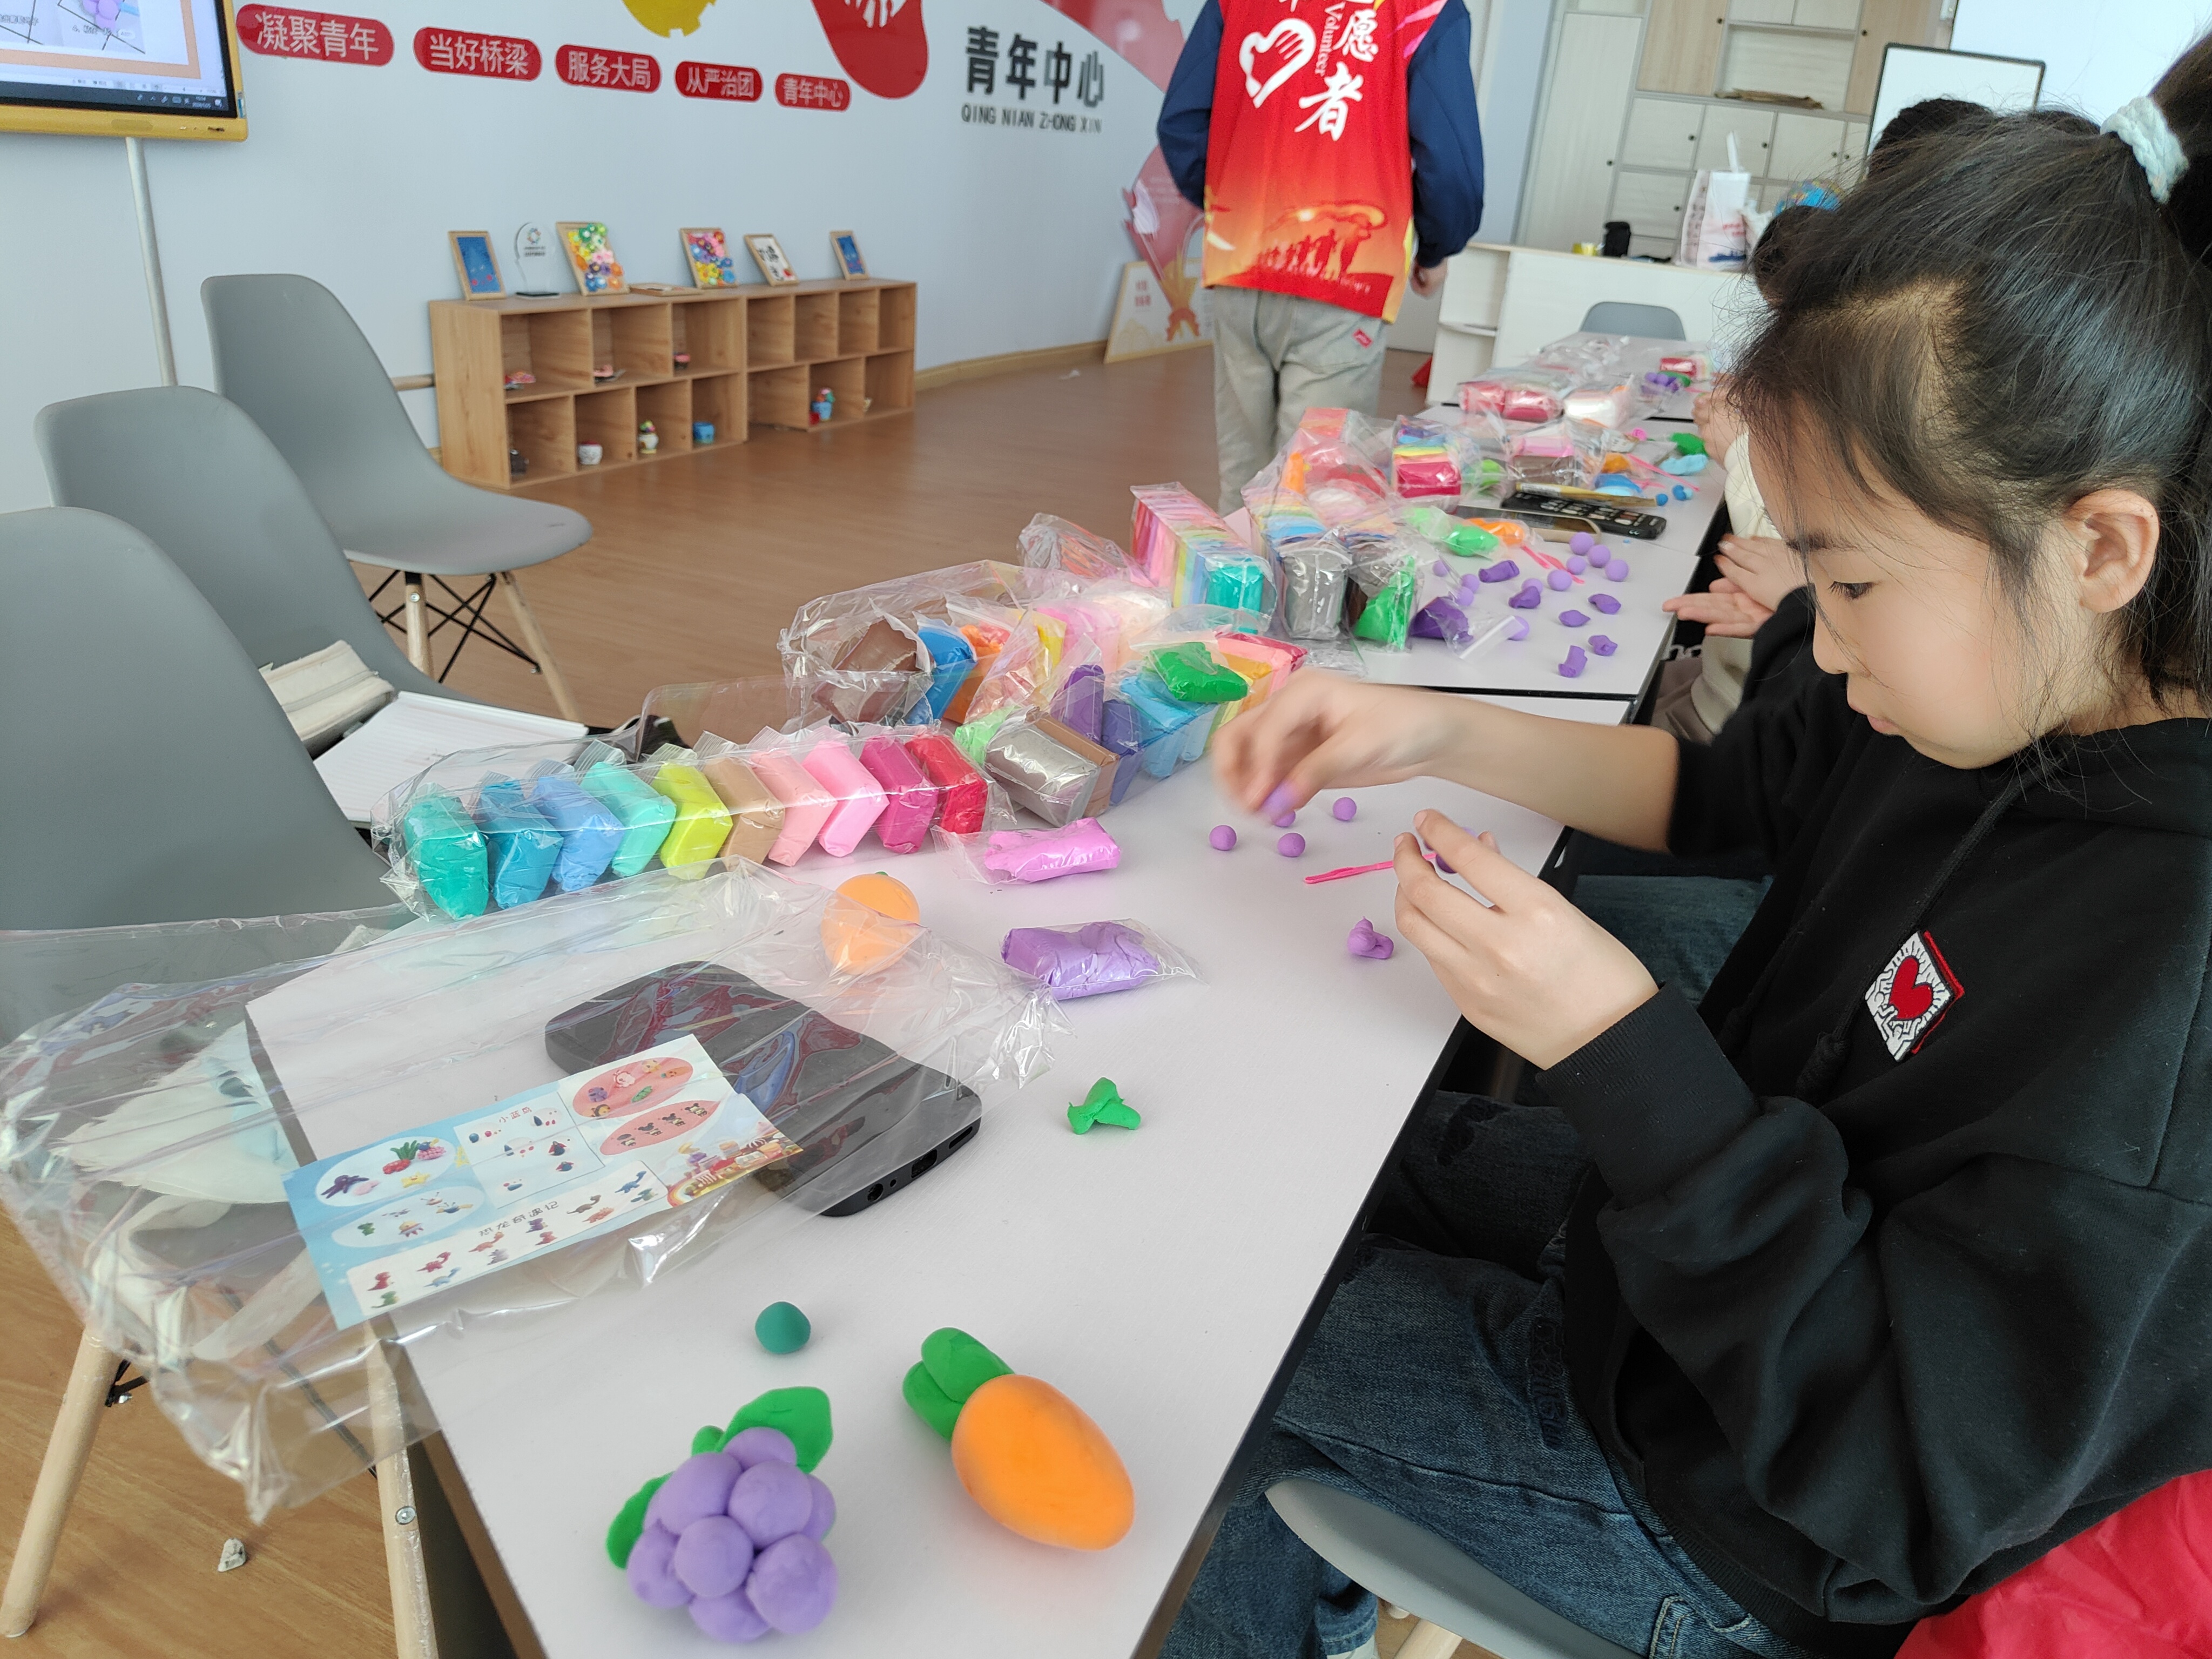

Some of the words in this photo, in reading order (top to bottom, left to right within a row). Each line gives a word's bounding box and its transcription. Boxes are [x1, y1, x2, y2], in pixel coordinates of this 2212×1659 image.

[254, 12, 379, 61] 凝聚青年
[430, 33, 529, 76] 当好桥梁
[1314, 2, 1346, 77] Volunteer
[568, 51, 651, 90] 服务大局
[685, 66, 754, 99] 从严治团
[966, 26, 1104, 108] 青年中心
[1294, 0, 1378, 141] 愿者
[783, 77, 844, 107] 青年中心
[961, 104, 996, 125] QING
[1001, 108, 1035, 128] NIAN
[1038, 111, 1076, 132] ZHONG
[1080, 116, 1102, 134] XIN
[498, 1106, 532, 1123] 小蓝鸟
[478, 1201, 559, 1237] 恐龙奇遇记
